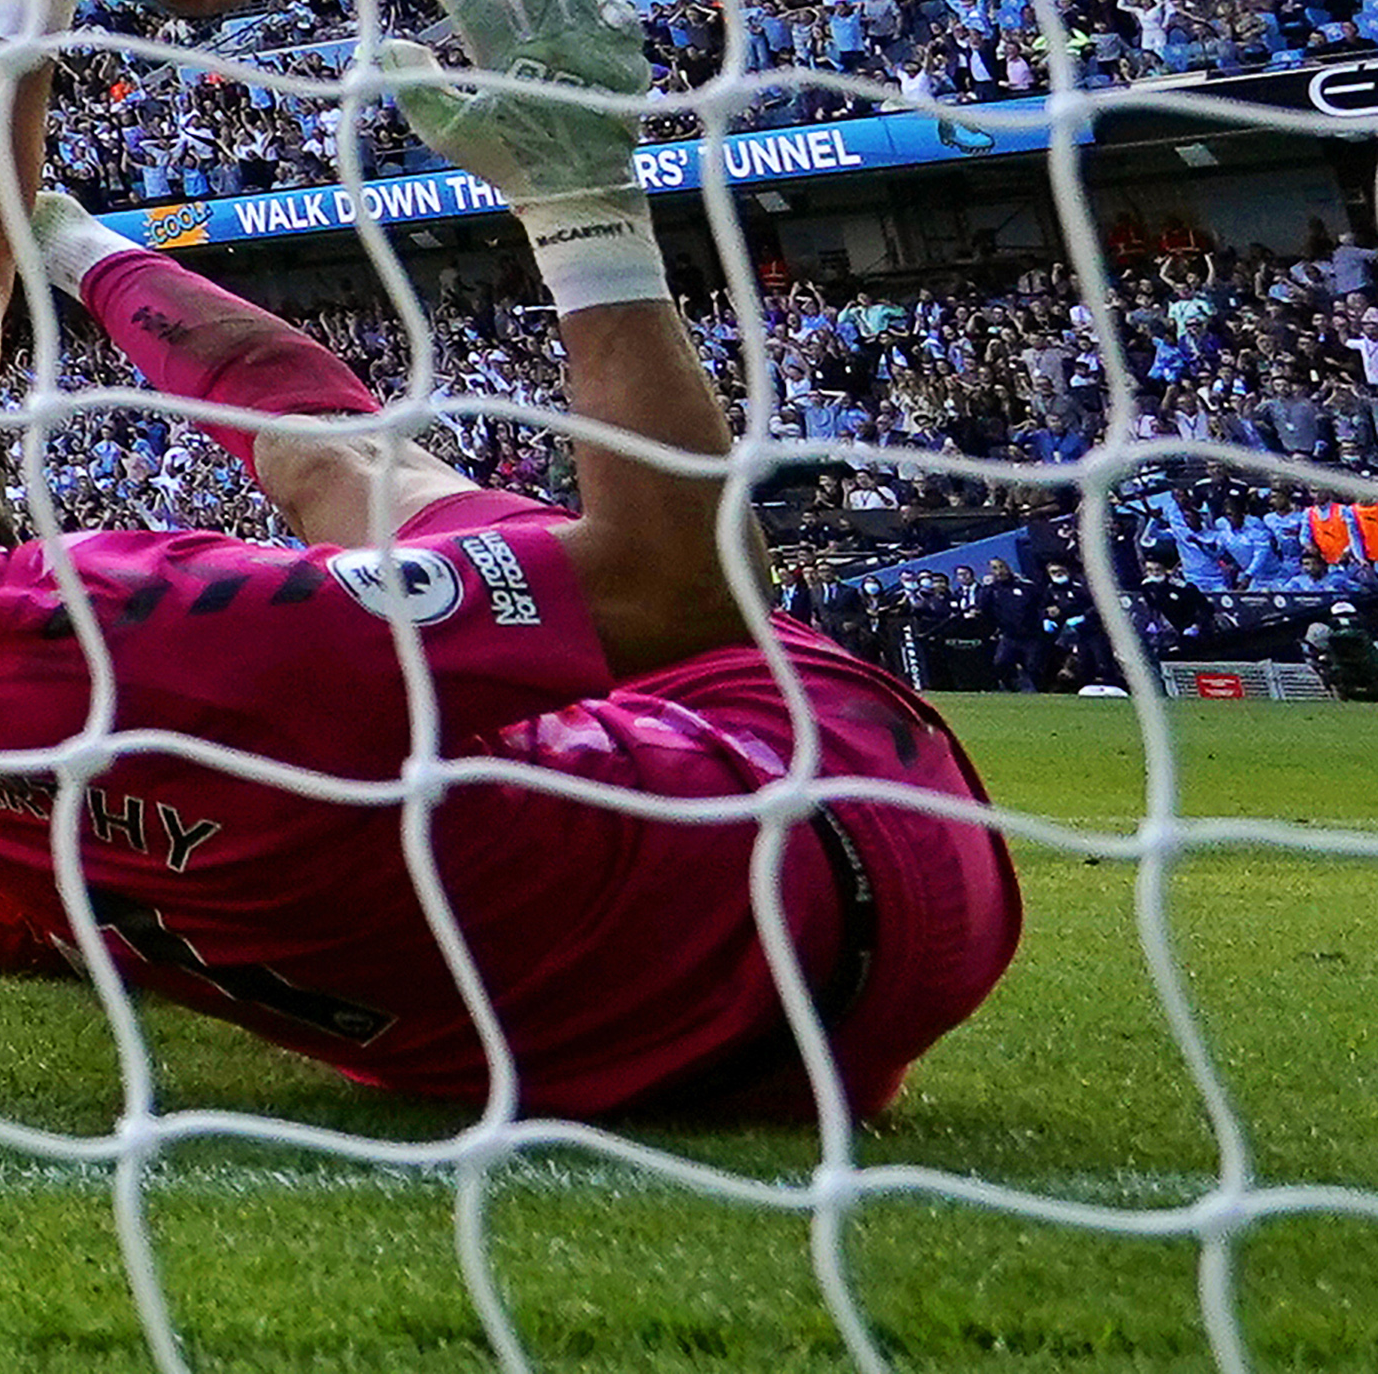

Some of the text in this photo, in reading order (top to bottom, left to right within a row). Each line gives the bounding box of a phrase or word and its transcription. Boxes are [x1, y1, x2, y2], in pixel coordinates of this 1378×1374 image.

[234, 192, 331, 235] WALK
[333, 179, 442, 229] DOWN
[698, 129, 861, 179] UNNEL
[463, 538, 519, 624] No room
